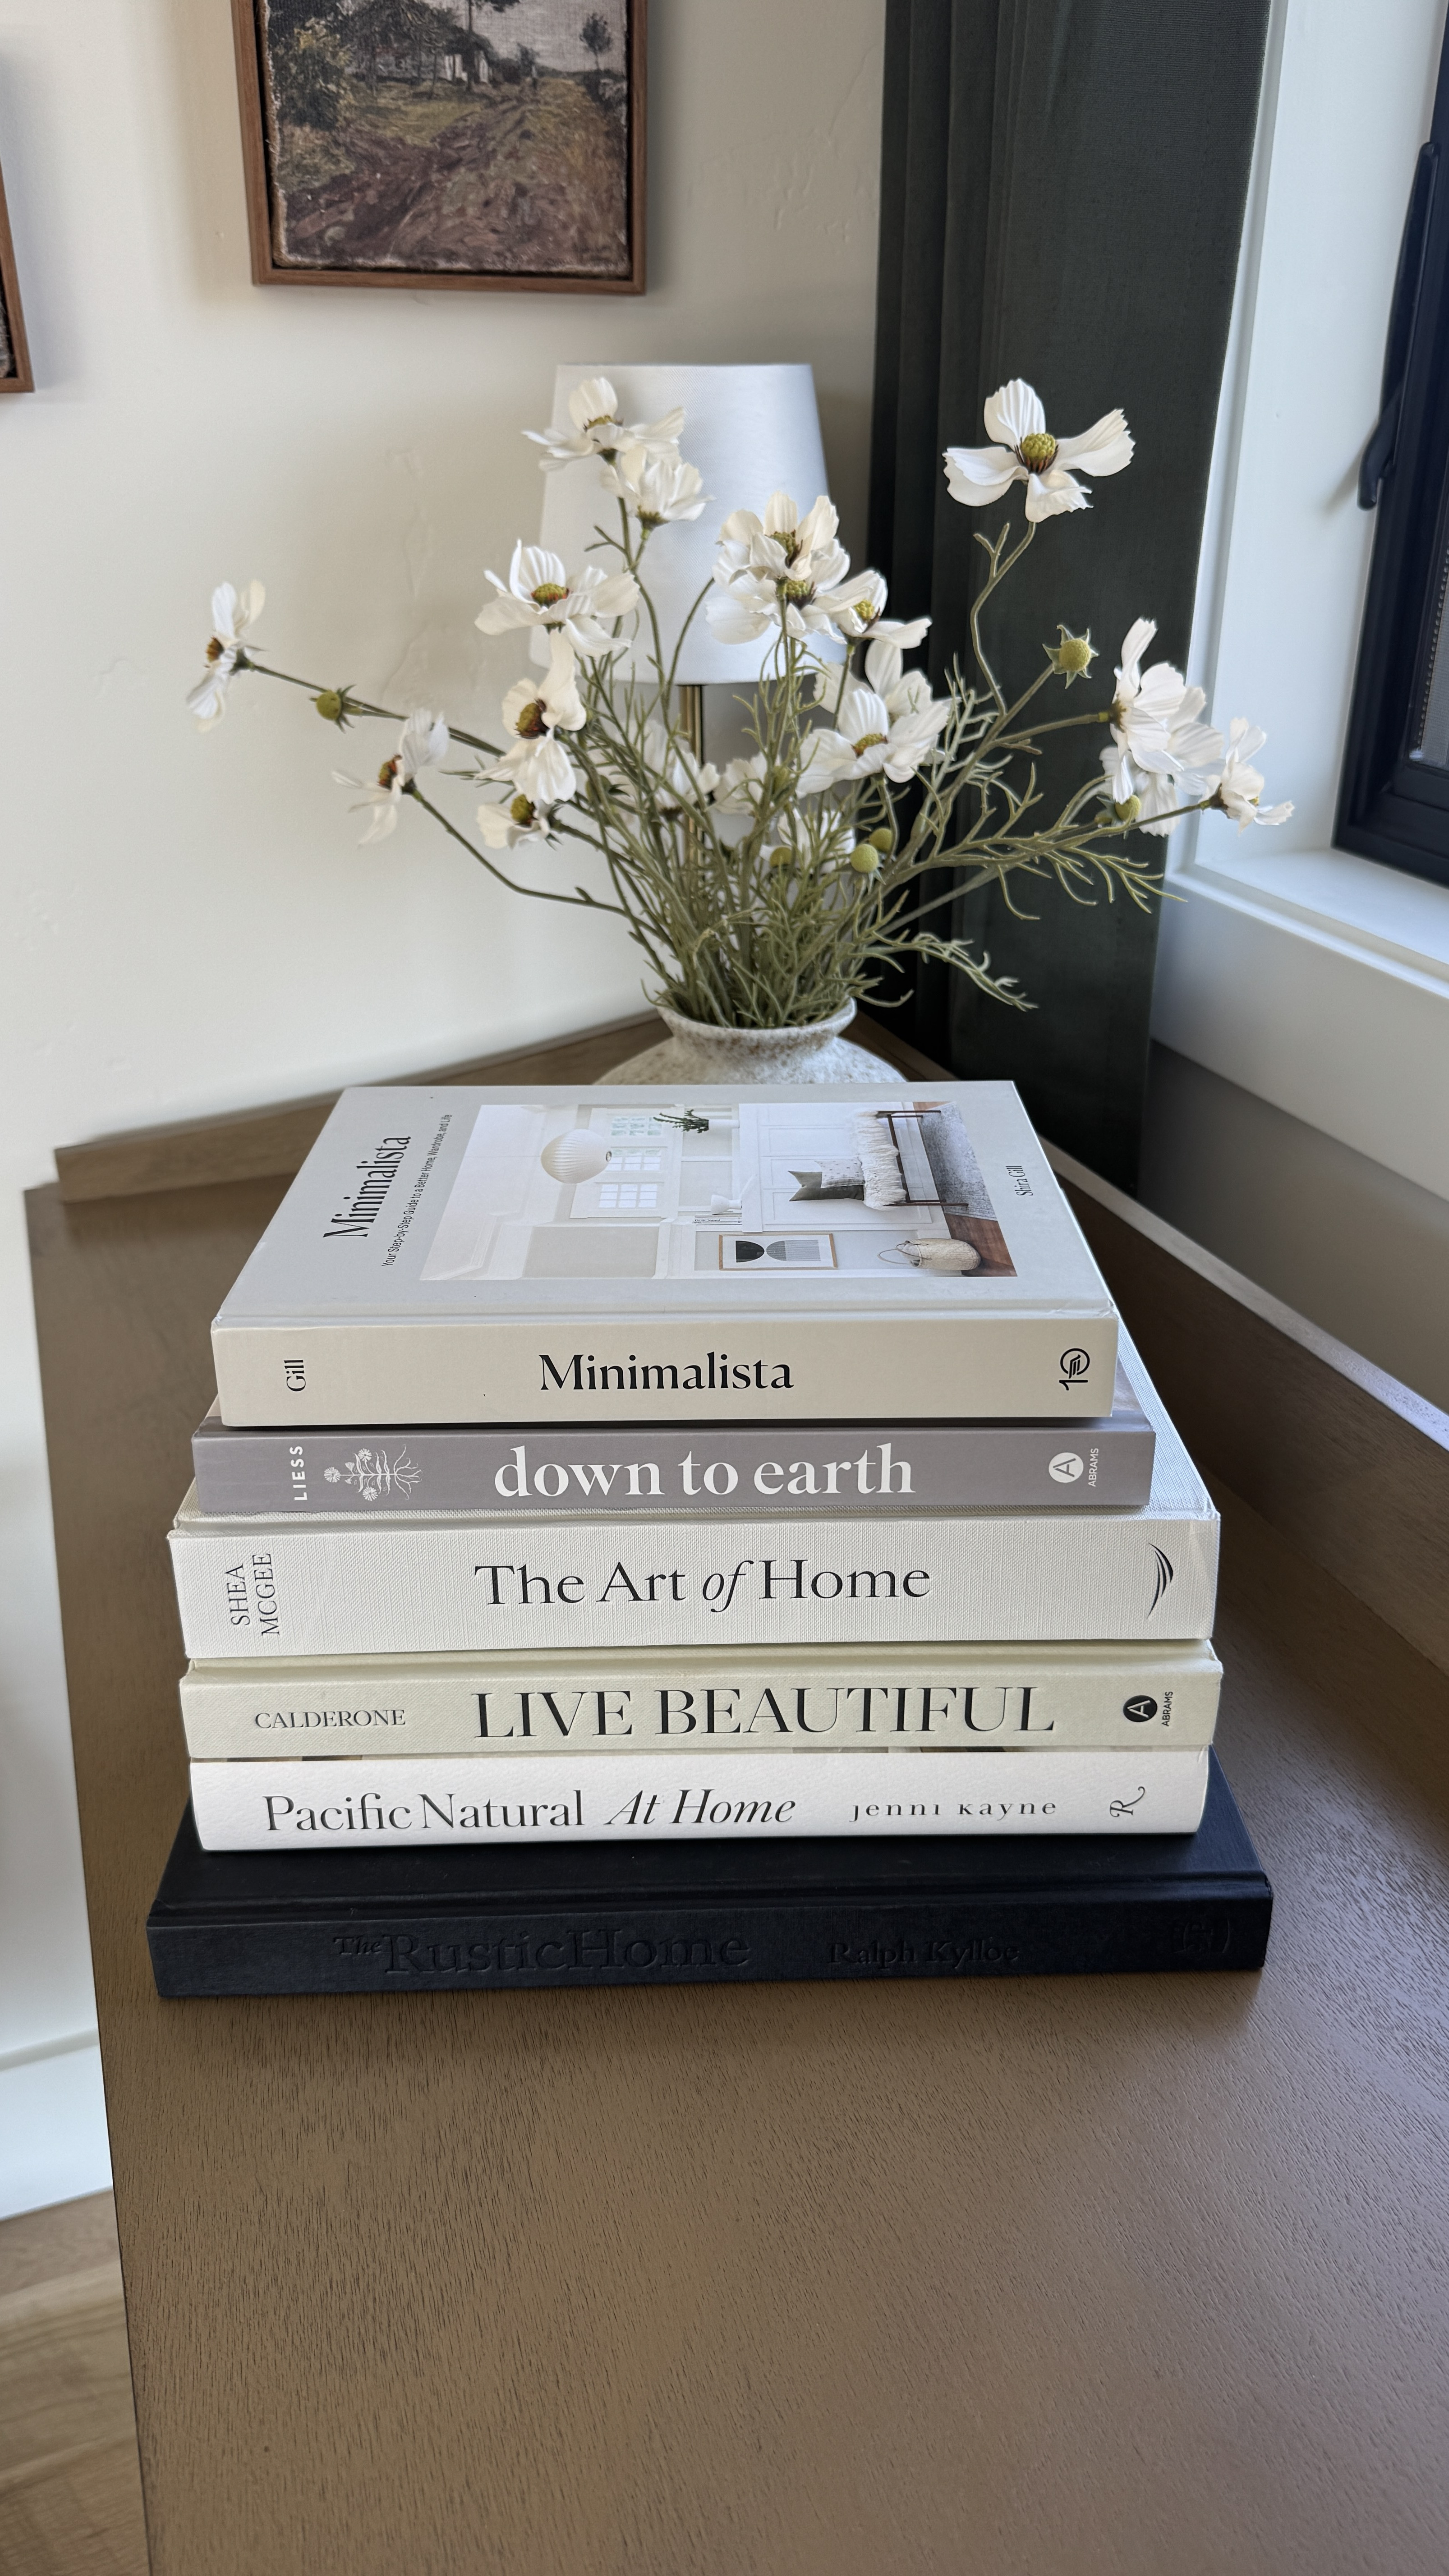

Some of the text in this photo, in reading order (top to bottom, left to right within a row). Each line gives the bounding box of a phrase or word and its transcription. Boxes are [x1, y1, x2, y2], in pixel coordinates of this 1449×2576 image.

[414, 1173, 429, 1188] Better
[421, 1156, 437, 1172] Home,
[1005, 1166, 1033, 1196] Shira Gill
[322, 1136, 412, 1237] Minimalista
[403, 1199, 419, 1215] Guide
[387, 1216, 414, 1252] Step-by-Step
[381, 1253, 397, 1266] Your
[283, 1359, 306, 1392] Gill
[538, 1351, 794, 1390] Minimalista
[290, 1445, 308, 1501] LIESS
[495, 1443, 916, 1497] down to earth
[1088, 1448, 1099, 1487] ABRAMS
[225, 1564, 251, 1626] SHEA
[252, 1553, 280, 1636] MCGEE
[474, 1559, 931, 1613] The Art of Home
[254, 1709, 406, 1729] CALDERONE
[471, 1687, 1055, 1738] LIVE BEAUTIFUL
[1161, 1691, 1173, 1727] ABRAMS
[262, 1788, 796, 1831] Pacific Natural At Home
[332, 1934, 382, 1955] The
[828, 1939, 919, 1972] Ralph
